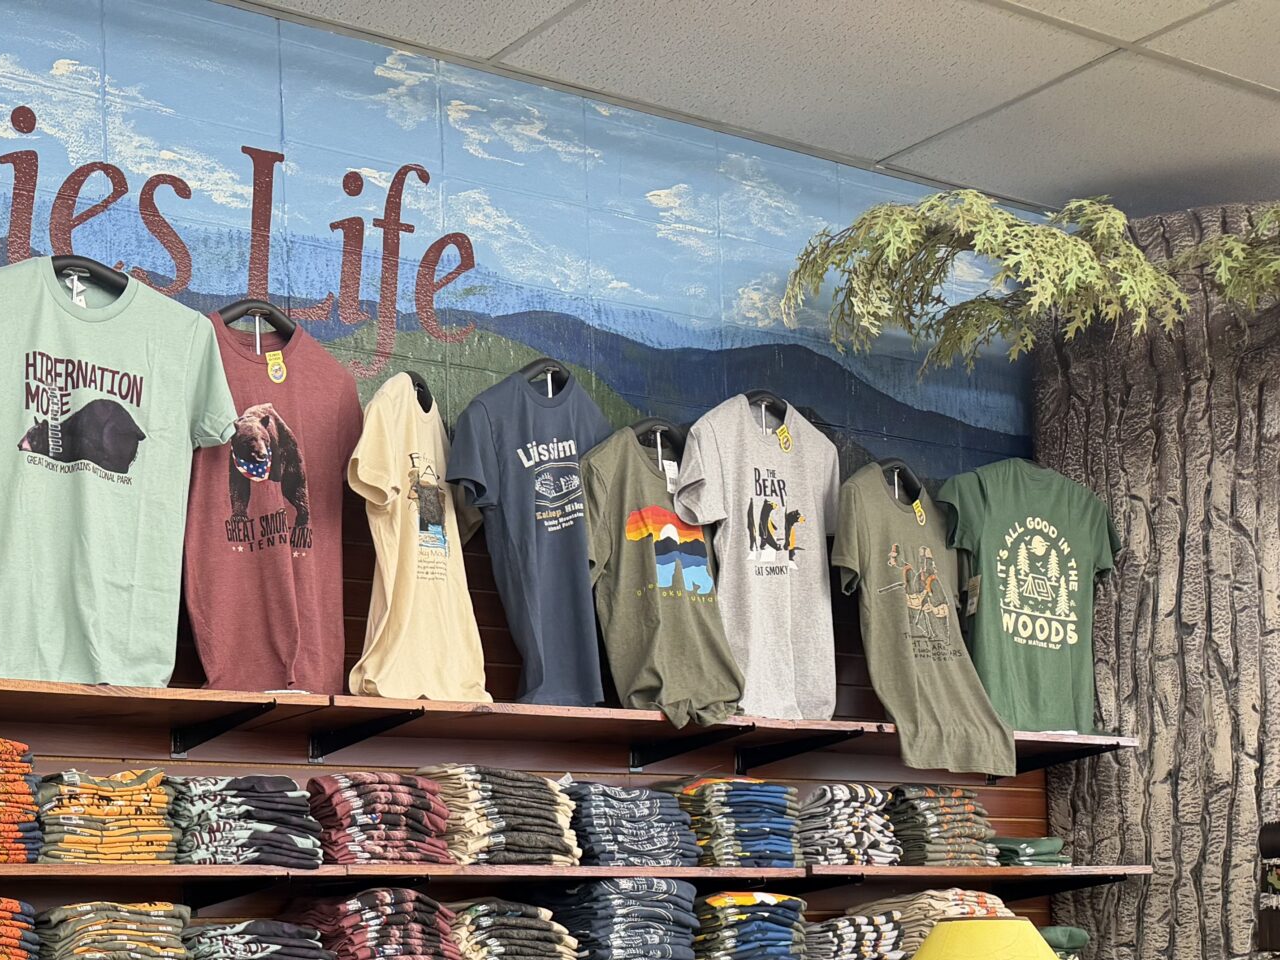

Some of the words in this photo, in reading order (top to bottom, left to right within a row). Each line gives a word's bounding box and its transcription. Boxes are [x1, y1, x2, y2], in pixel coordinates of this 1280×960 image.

[241, 145, 477, 374] Life
[25, 350, 144, 408] HIBERNATION
[24, 381, 72, 417] MOE
[26, 454, 45, 468] GREAT
[60, 461, 92, 474] MOUNTAINS
[117, 475, 132, 486] PARK
[753, 467, 788, 508] BEAR
[766, 468, 777, 479] THE
[224, 519, 256, 543] GREAT
[766, 564, 789, 577] SMOKY
[1004, 521, 1024, 548] ALL
[1026, 516, 1058, 538] GOOD
[1058, 537, 1071, 556] IN
[1067, 558, 1078, 592] THE
[1000, 608, 1079, 645] WOODS
